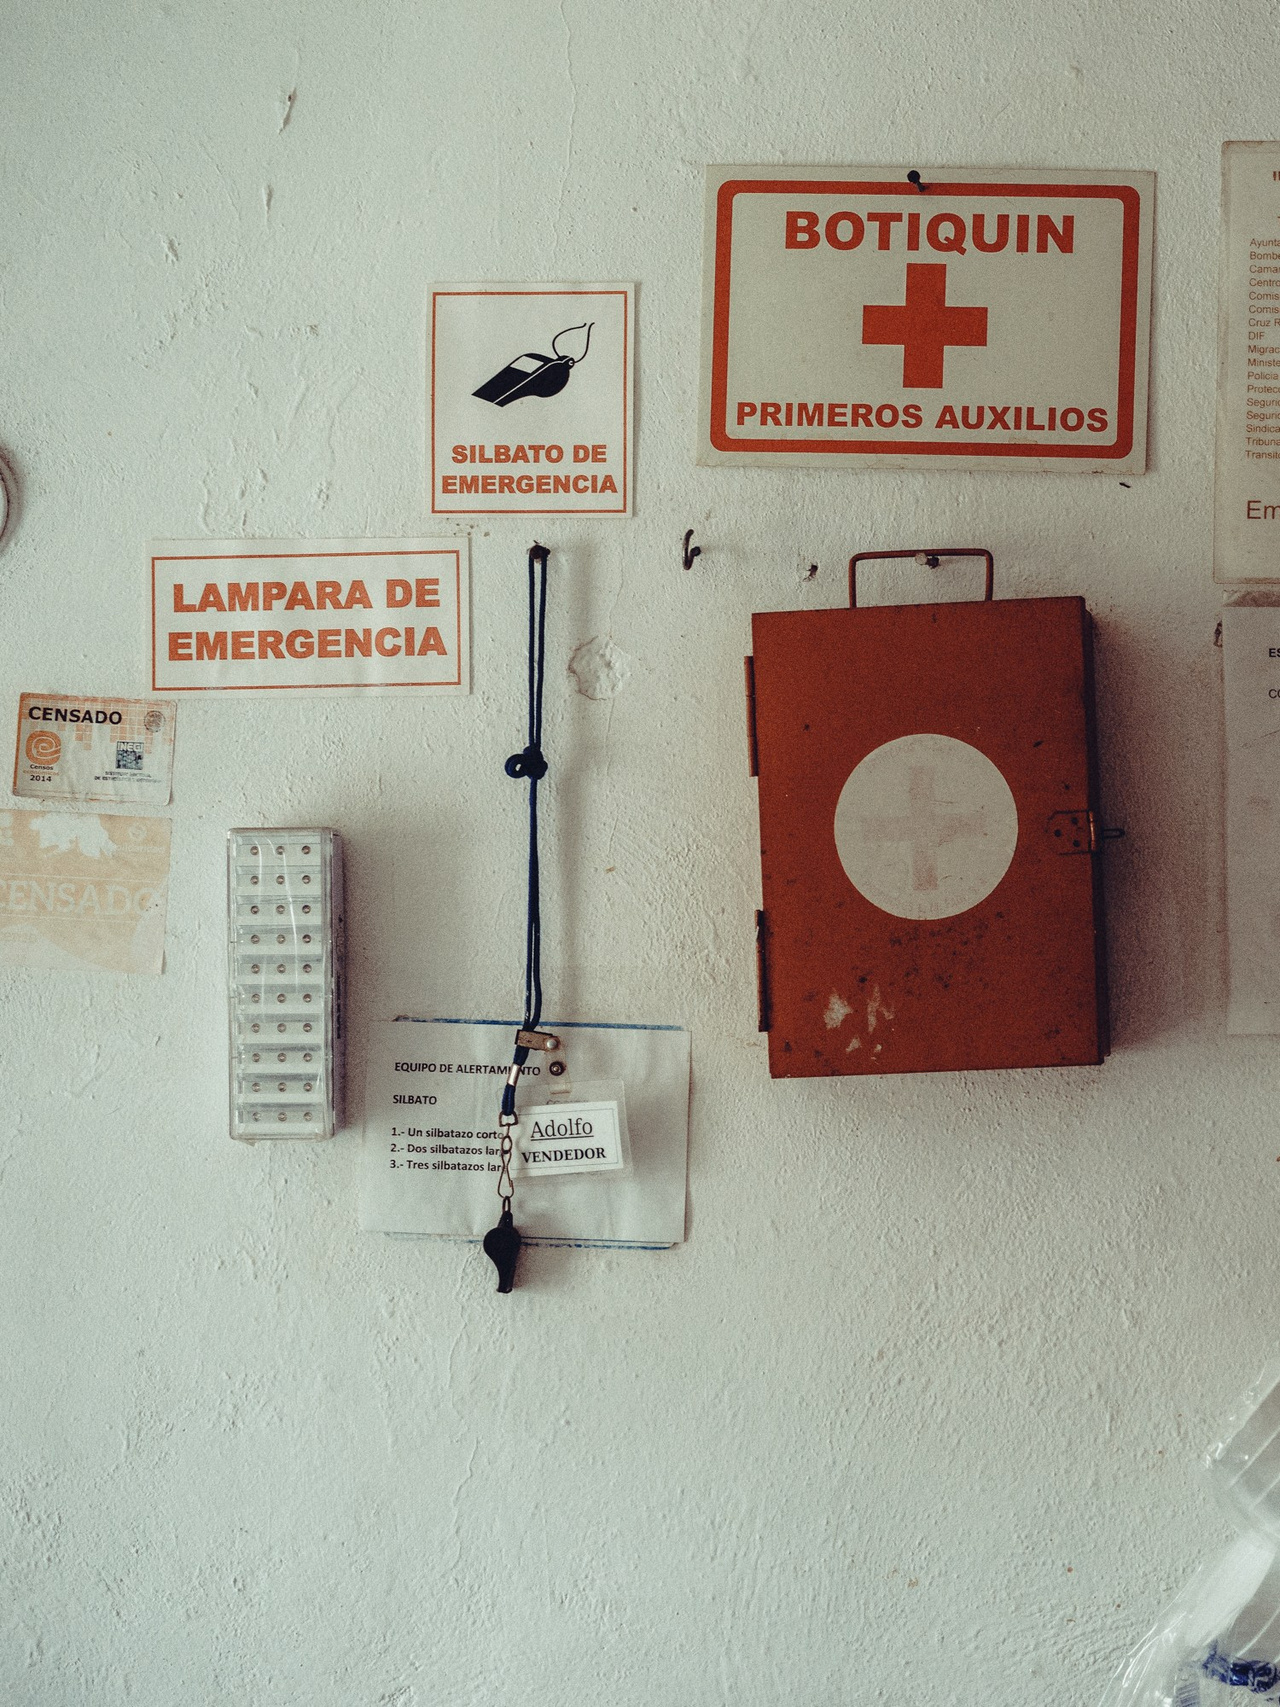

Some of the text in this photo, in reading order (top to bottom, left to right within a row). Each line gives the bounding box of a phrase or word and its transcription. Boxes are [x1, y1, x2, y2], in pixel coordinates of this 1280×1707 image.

[785, 211, 1074, 255] BOTIQUIN
[1249, 319, 1271, 328] Cruz
[1249, 332, 1264, 340] DIF
[737, 402, 1108, 432] PRIMEROS AUXILIOS
[452, 445, 606, 463] SILBATO DE
[442, 474, 617, 494] EMERGENCIA
[173, 577, 440, 612] LAMPARA DE
[168, 626, 447, 661] EMERGENCIA
[29, 706, 122, 724] CENSADO
[395, 1062, 540, 1076] EQUIPO DE ALERTAMINTO
[393, 1094, 437, 1105] SILBATO
[391, 1128, 405, 1137] 1.-
[408, 1128, 422, 1138] Un
[426, 1127, 474, 1139] silbatazo
[531, 1118, 593, 1139] Adolfo
[391, 1144, 482, 1155] 2.- Dos silbatazos
[522, 1147, 606, 1163] VENDEDOR
[390, 1159, 485, 1171] 3.- Tres silbatazos
